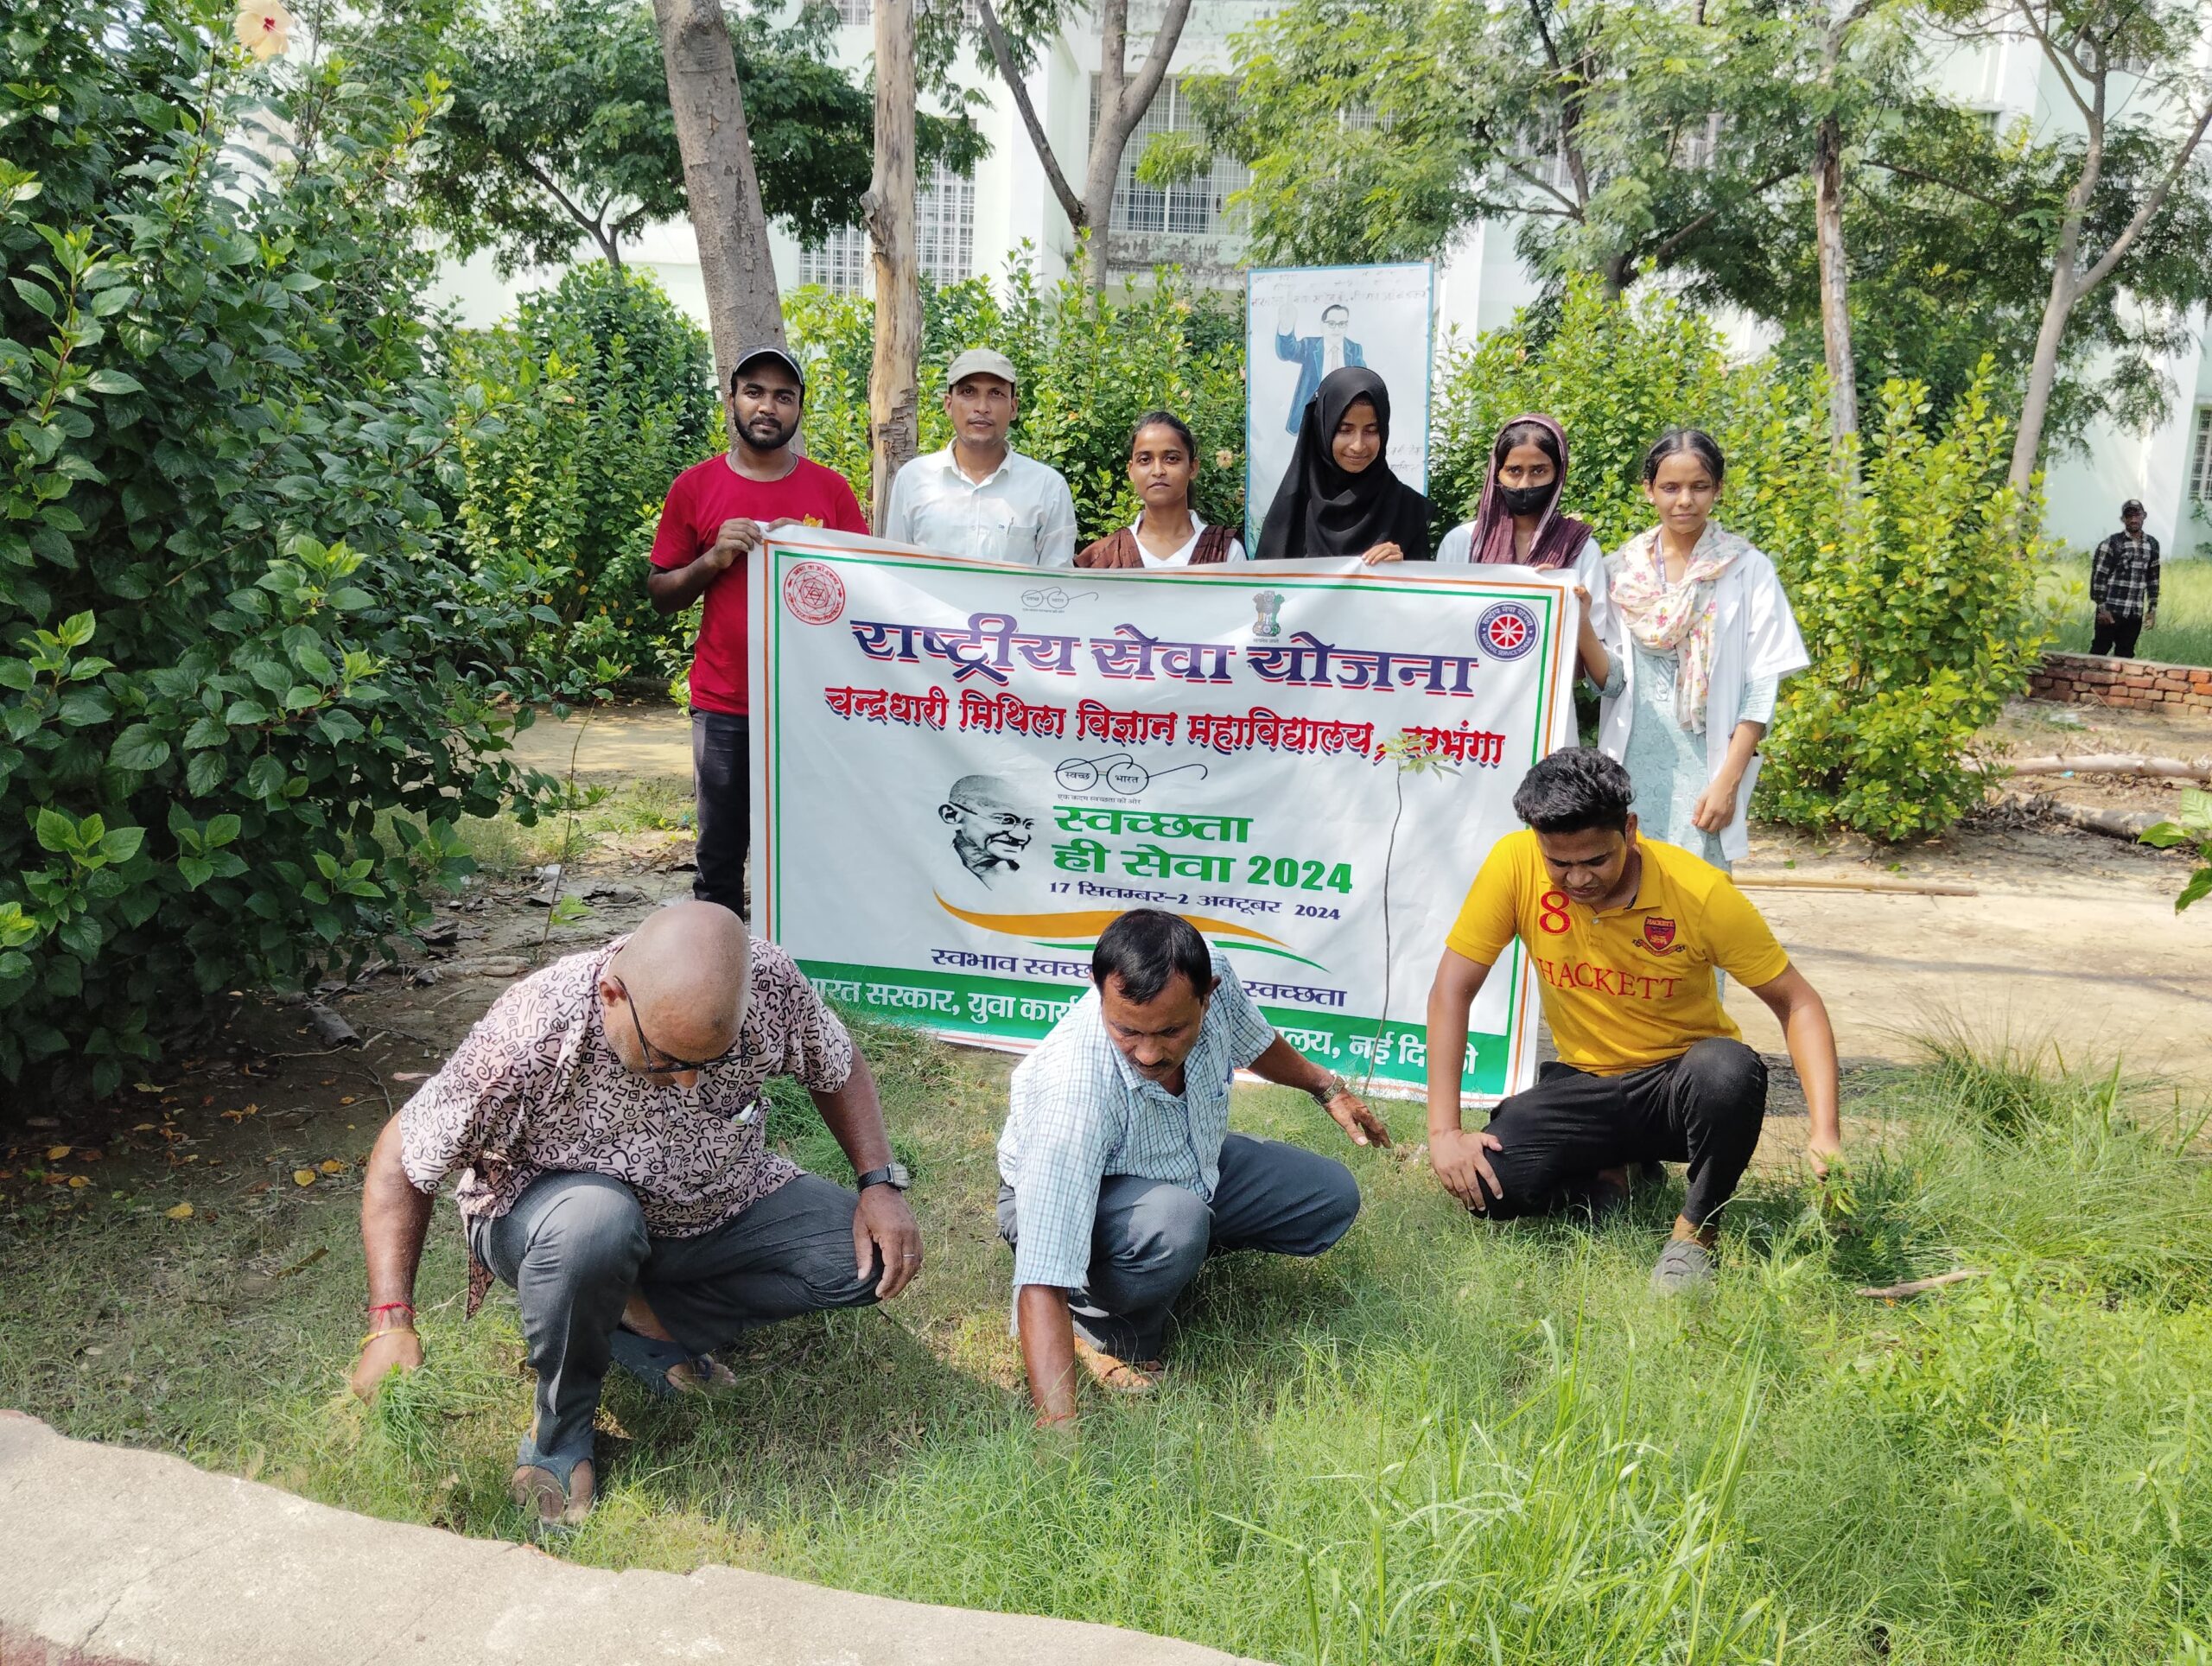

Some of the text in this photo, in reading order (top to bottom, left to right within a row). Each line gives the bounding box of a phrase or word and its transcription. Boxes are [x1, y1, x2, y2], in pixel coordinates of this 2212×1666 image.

[850, 612, 1478, 697] राष्ट्रीय सेवा योजना
[824, 685, 950, 732] चन्द्रधारी
[959, 691, 1067, 742] मिथिला
[1077, 698, 1177, 748] विज्ञान
[1057, 793, 1070, 802] एक
[1090, 796, 1116, 804] स्वच्छता
[1116, 795, 1127, 804] की
[1128, 797, 1142, 805] ओर
[1065, 771, 1140, 784] स्वच्छ भारत
[1053, 805, 1254, 843] स्वच्छता
[1051, 837, 1353, 894] ही सेवा 2024
[1050, 881, 1071, 893] 17
[1197, 894, 1282, 916] अक्टूबर
[1294, 904, 1341, 921] 2024
[1539, 890, 1571, 935] 8
[931, 949, 1347, 1007] स्वभाव स्वच्छ स्वच्छता
[1536, 957, 1682, 1000] HACKETT
[866, 983, 961, 1016] सरकार,
[968, 993, 1016, 1025] युवा
[1349, 1031, 1395, 1065] नई
